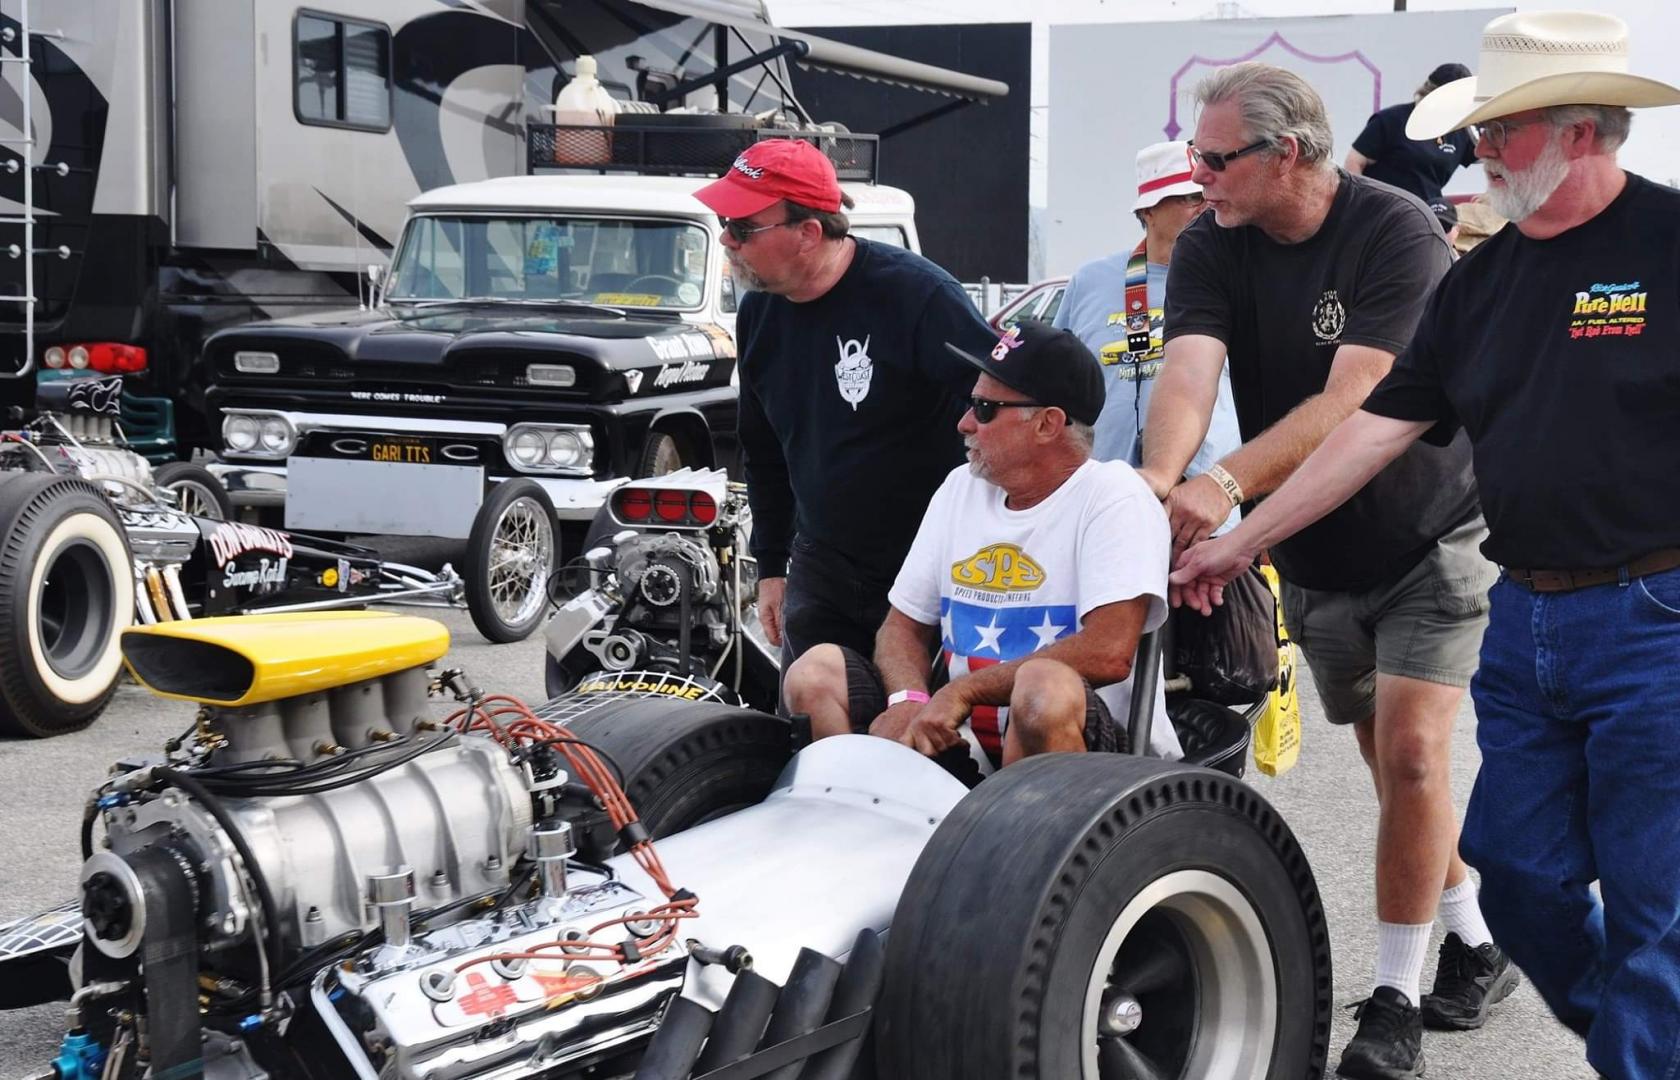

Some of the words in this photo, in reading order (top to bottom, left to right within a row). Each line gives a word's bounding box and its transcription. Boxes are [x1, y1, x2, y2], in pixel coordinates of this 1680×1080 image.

[1572, 291, 1609, 315] Pure
[1606, 291, 1648, 316] Hell
[373, 392, 400, 401] COMES
[222, 561, 260, 592] Swamp
